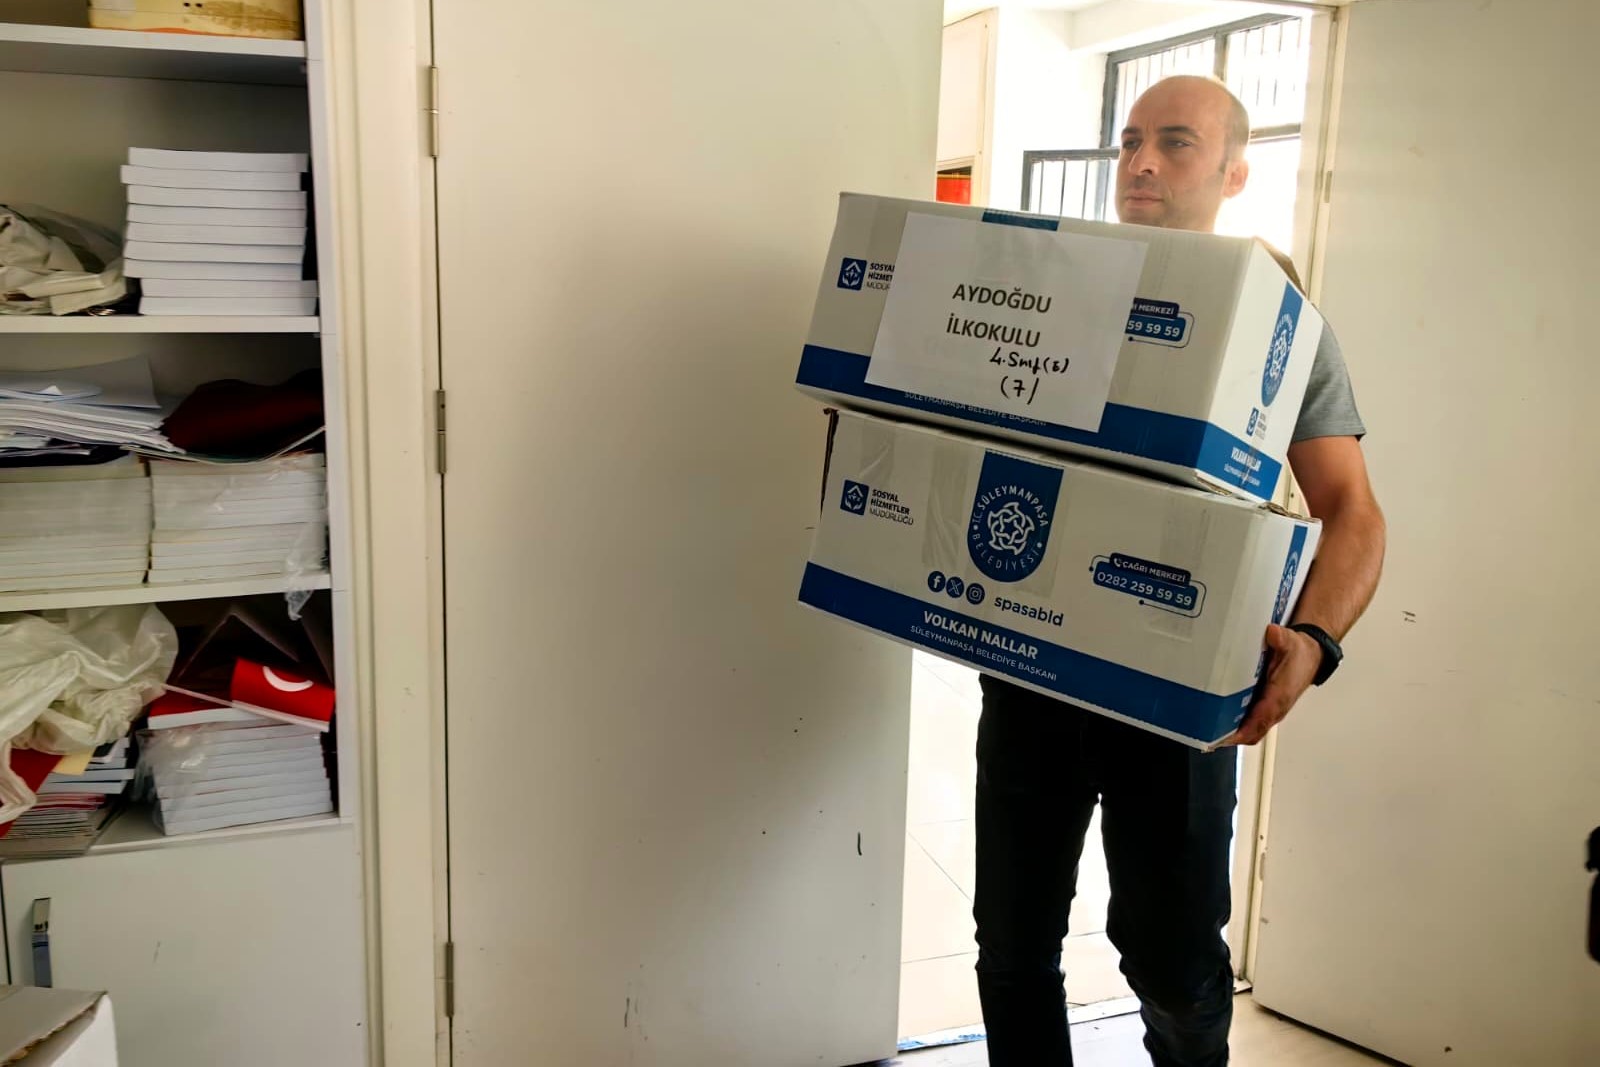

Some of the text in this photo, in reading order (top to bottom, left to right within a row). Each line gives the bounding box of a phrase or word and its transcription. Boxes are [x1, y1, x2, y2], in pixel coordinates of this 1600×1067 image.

[952, 284, 1052, 313] AYDOĞDU
[946, 313, 1041, 347] İLKOKULU
[1145, 323, 1161, 334] 59
[1164, 325, 1180, 337] 59
[870, 498, 910, 515] HİZMETLER
[872, 489, 899, 502] SOSYAL
[972, 533, 1040, 571] BELEDİYESİ
[1097, 571, 1192, 606] 0282 259 59 59
[1149, 567, 1186, 583] MERKEZİ
[994, 596, 1064, 627] spasabld
[924, 610, 1038, 660] VOLKAN NALLAR
[910, 625, 1057, 682] SÜLEYMANPAŞA BELEDİYE BAŞKANI
